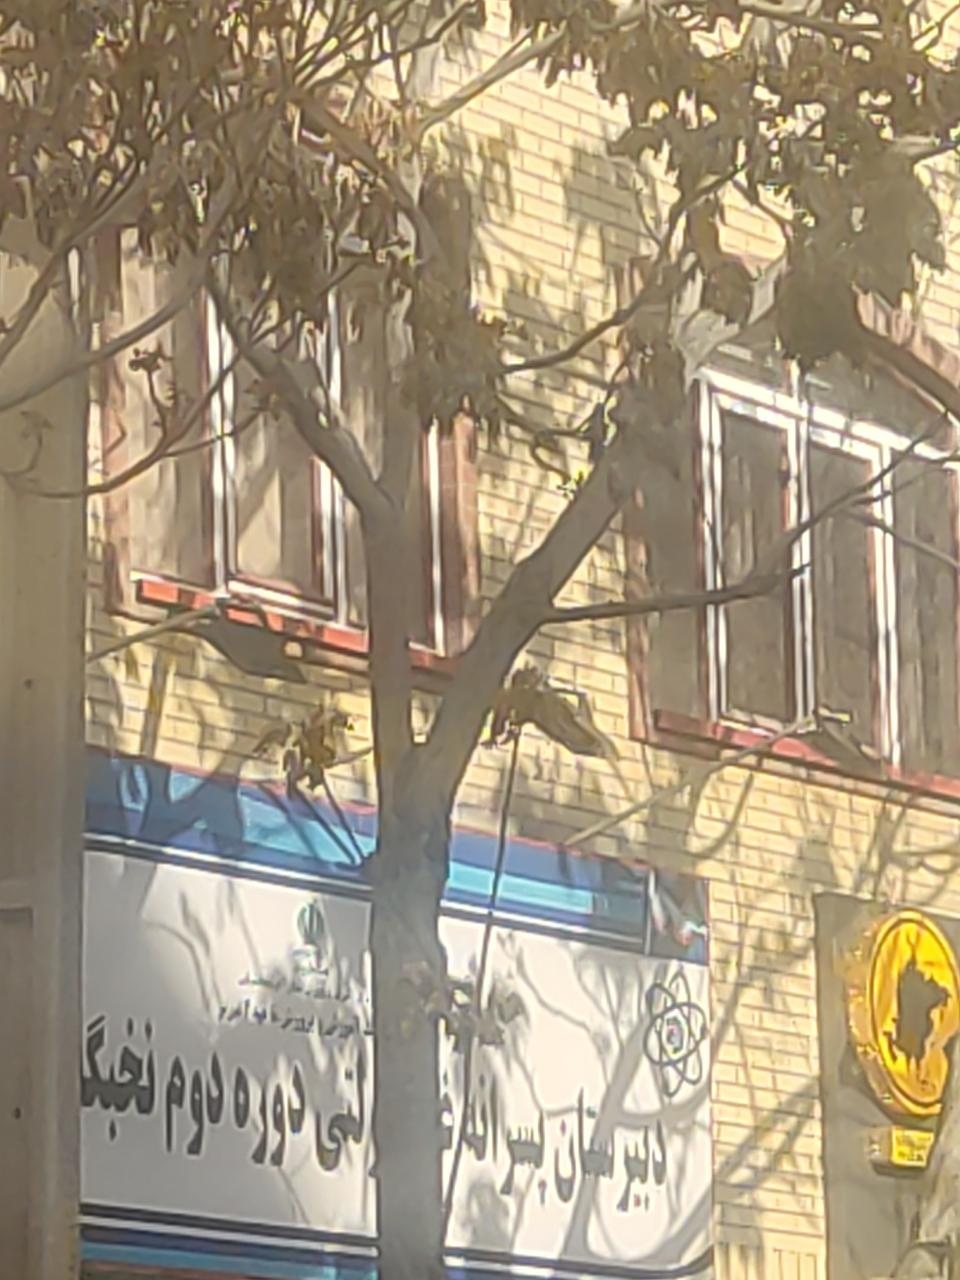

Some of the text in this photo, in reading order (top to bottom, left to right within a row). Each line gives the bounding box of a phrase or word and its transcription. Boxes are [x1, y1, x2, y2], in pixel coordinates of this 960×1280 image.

[166, 1051, 224, 1155] دوم
[234, 1064, 305, 1167] دوره
[554, 1087, 667, 1212] دبیرستان
